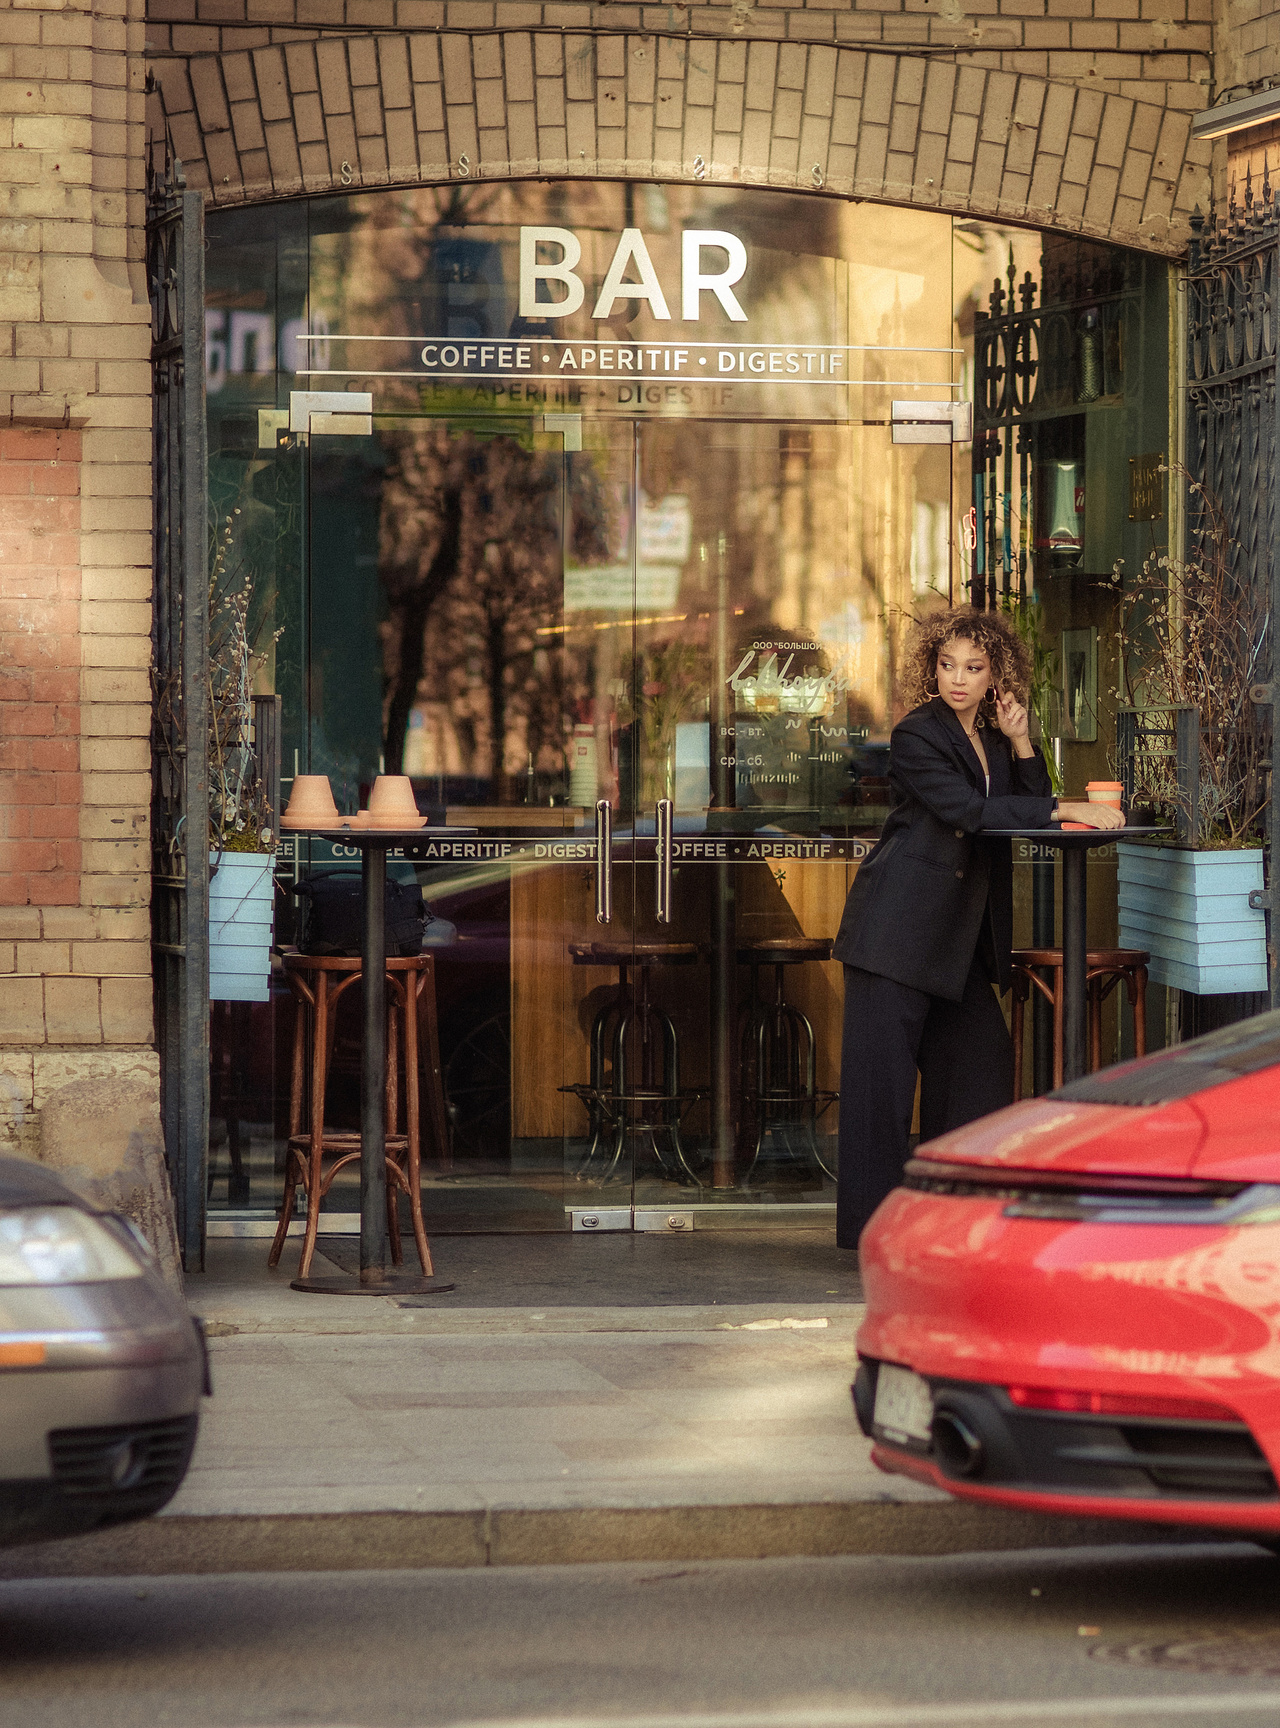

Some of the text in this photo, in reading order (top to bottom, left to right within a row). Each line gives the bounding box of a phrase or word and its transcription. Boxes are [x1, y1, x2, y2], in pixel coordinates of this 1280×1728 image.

[519, 225, 749, 322] BAR
[421, 345, 844, 374] COFFEE APERITIF DIGESTIF
[753, 641, 773, 649] ООО
[426, 843, 511, 857] APERITIF
[534, 844, 599, 858] DIGEST
[747, 844, 831, 857] APERITIF
